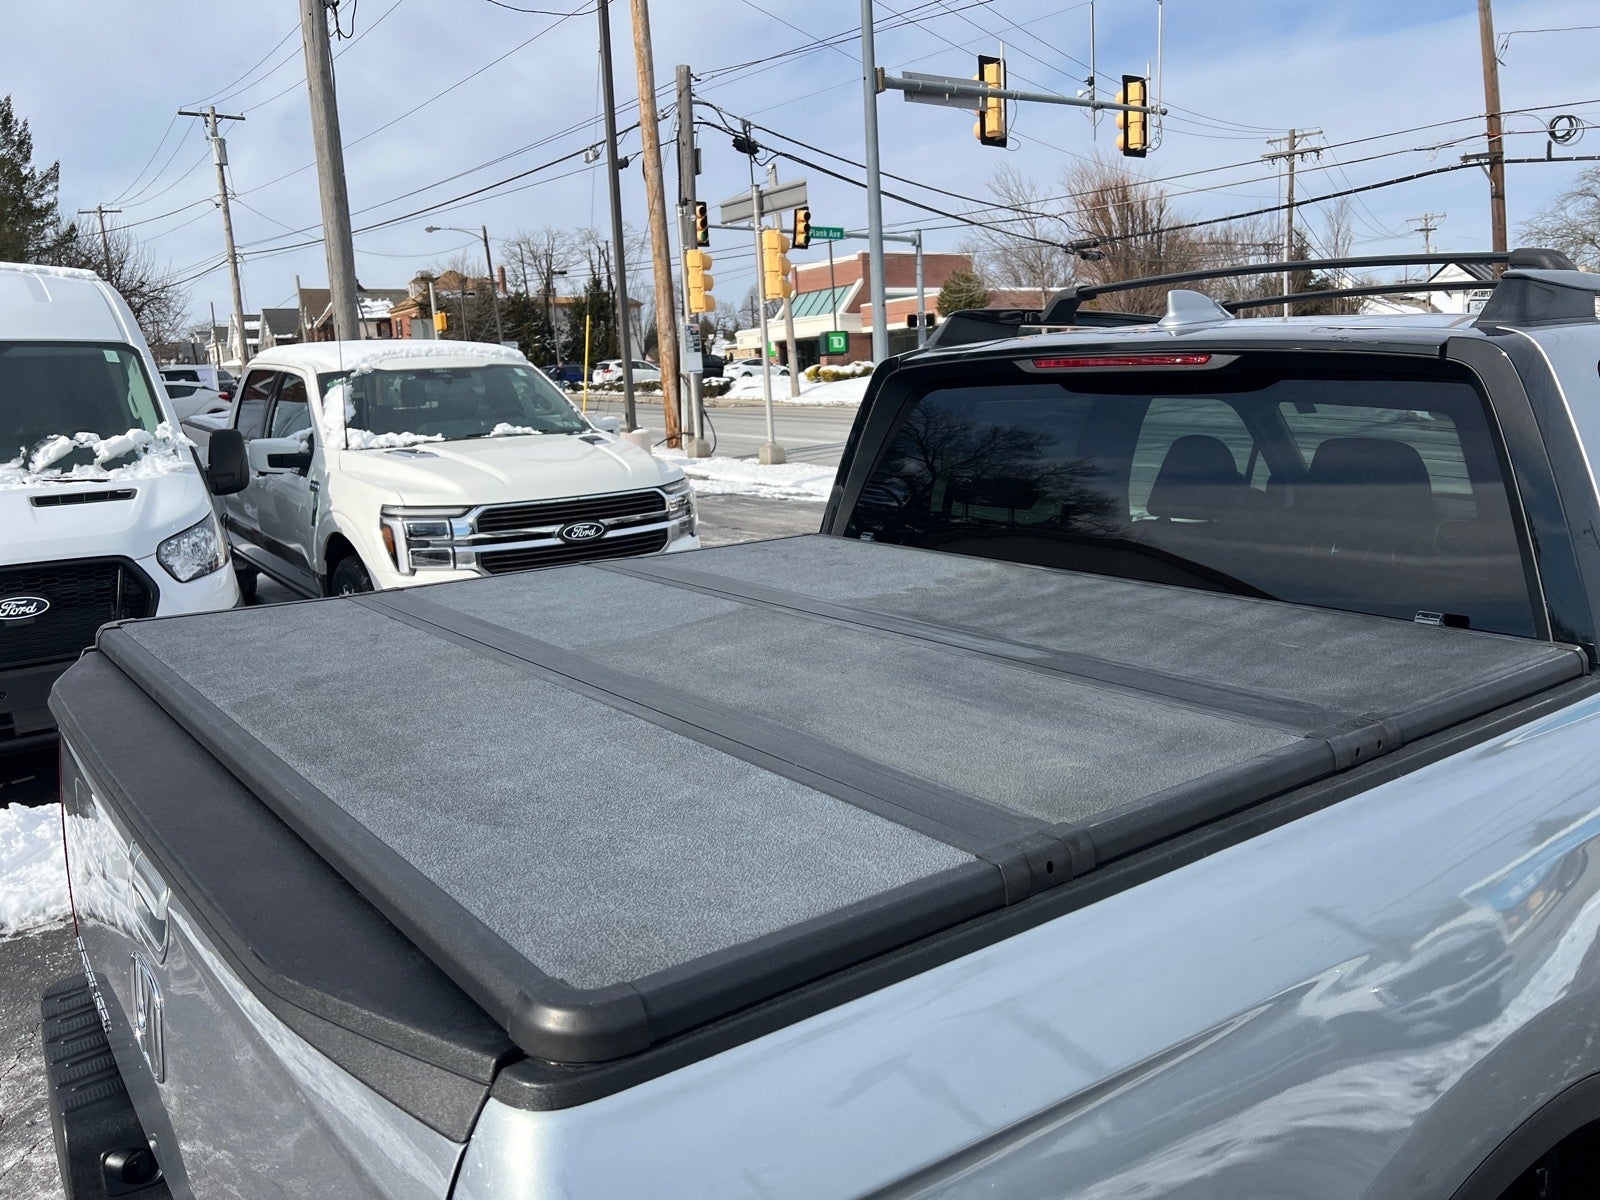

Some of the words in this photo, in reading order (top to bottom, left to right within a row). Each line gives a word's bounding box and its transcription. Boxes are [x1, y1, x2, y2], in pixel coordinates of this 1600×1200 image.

[809, 229, 827, 238] Plank
[829, 229, 841, 238] Ave
[1478, 290, 1492, 298] DEPO
[830, 336, 844, 348] TD
[571, 524, 597, 538] Ford
[0, 599, 38, 617] Ford
